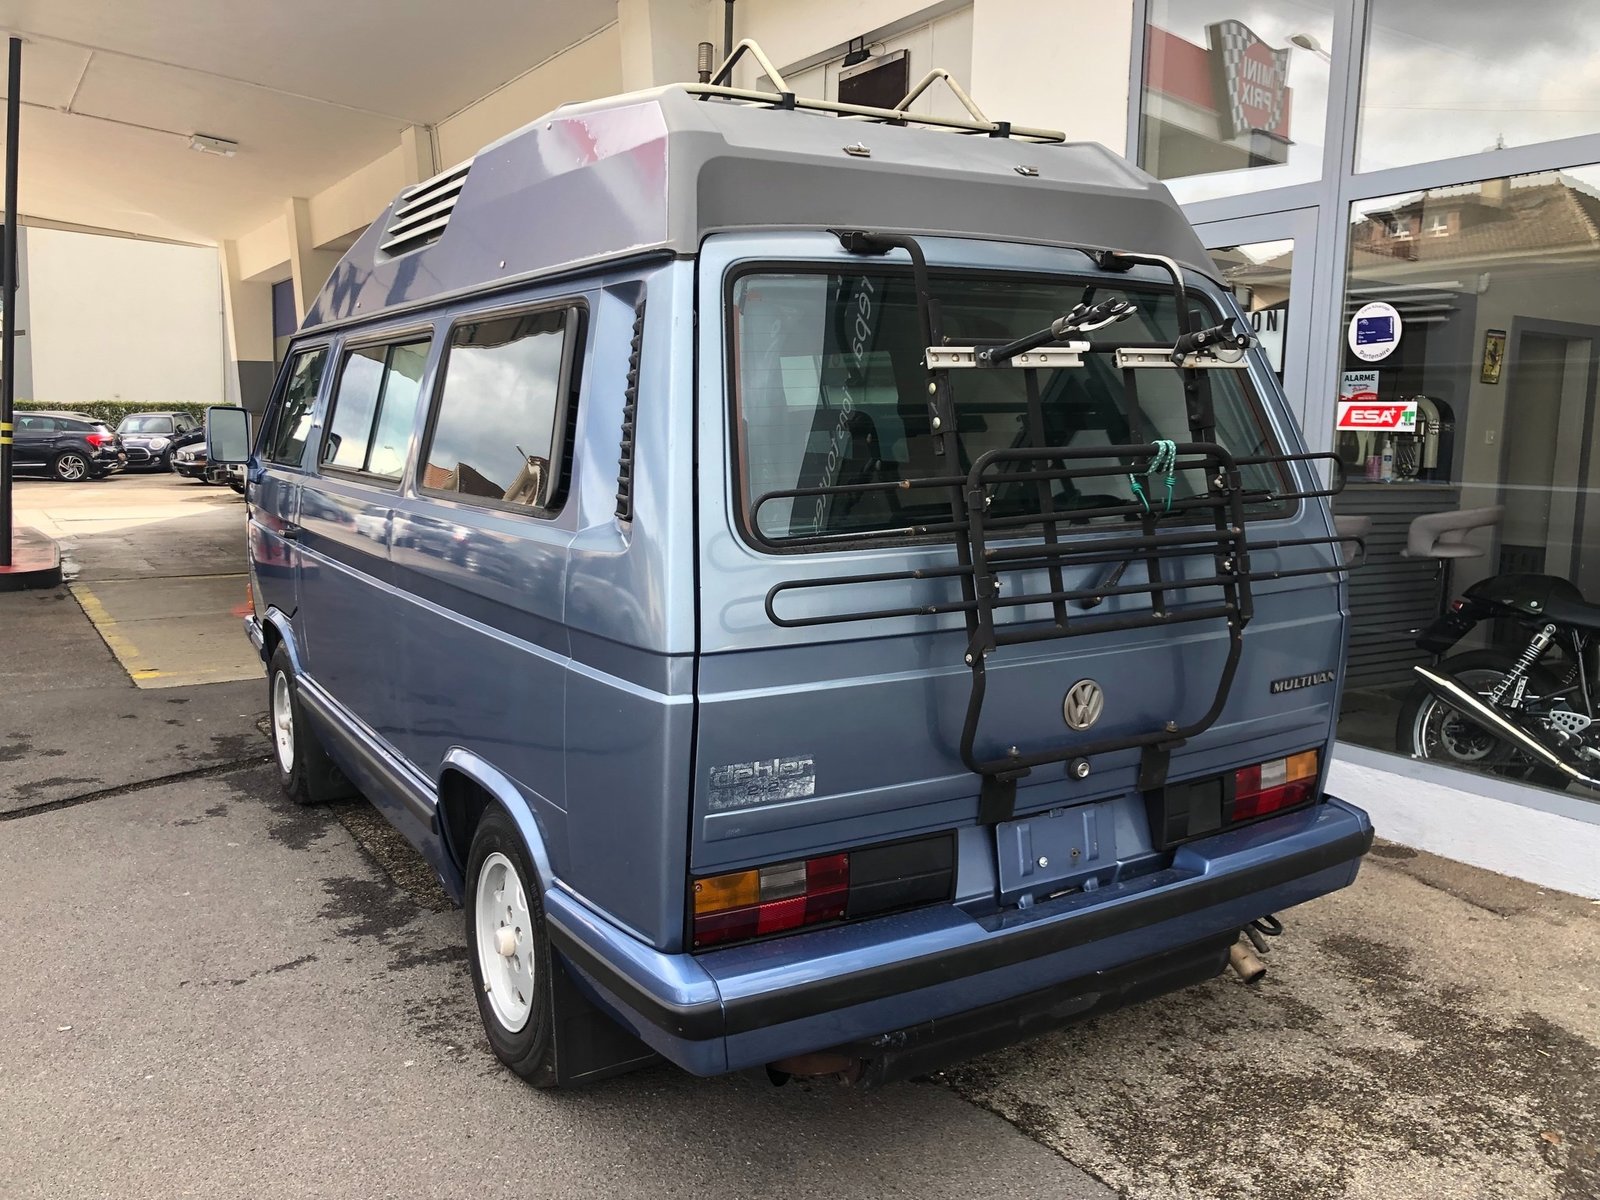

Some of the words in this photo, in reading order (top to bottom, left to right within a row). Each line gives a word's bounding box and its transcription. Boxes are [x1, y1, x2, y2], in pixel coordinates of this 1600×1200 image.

[1247, 309, 1278, 333] ON
[1344, 374, 1376, 382] ALARME
[1273, 671, 1336, 693] MULTIVAN
[711, 758, 813, 786] dehler
